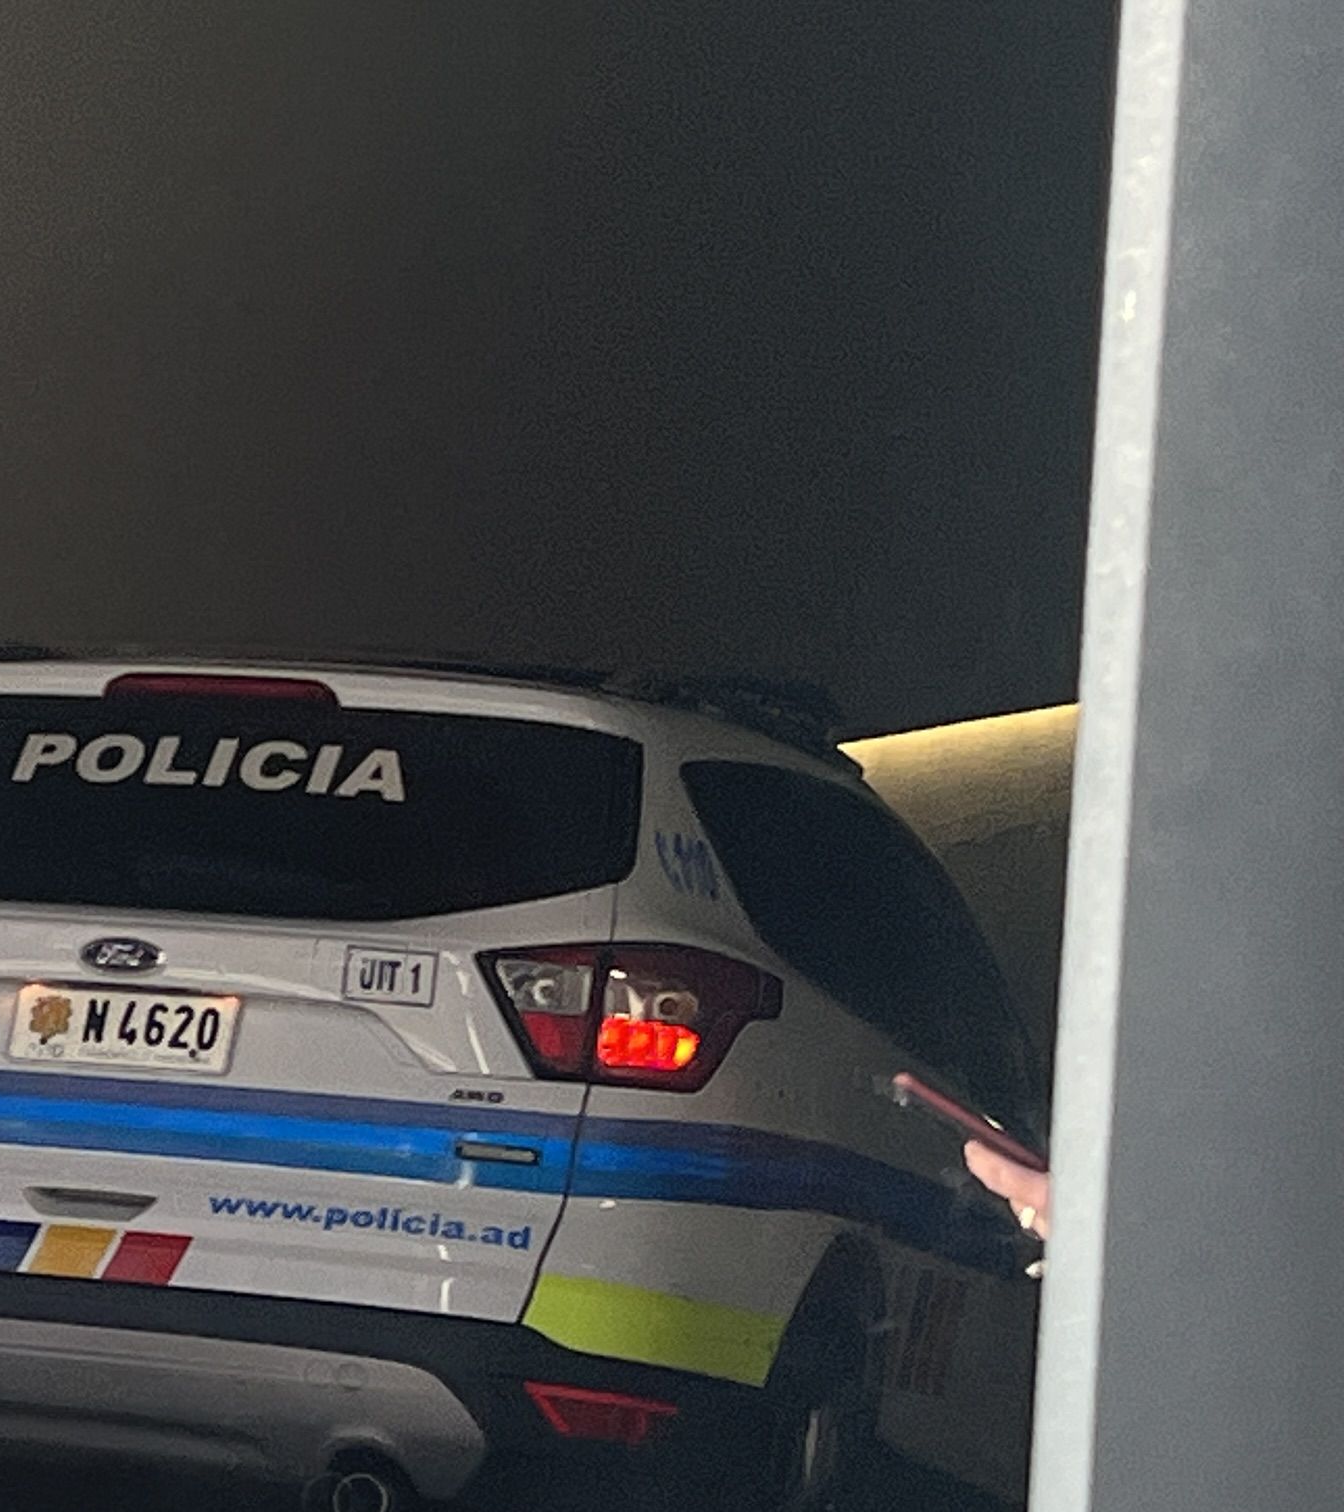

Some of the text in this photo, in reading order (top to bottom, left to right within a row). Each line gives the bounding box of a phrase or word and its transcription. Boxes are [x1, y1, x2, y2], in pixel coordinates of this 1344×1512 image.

[11, 732, 406, 802] POLICIA
[411, 962, 422, 995] 1
[82, 998, 220, 1051] N 4620
[208, 1196, 532, 1250] www.policia.ad
